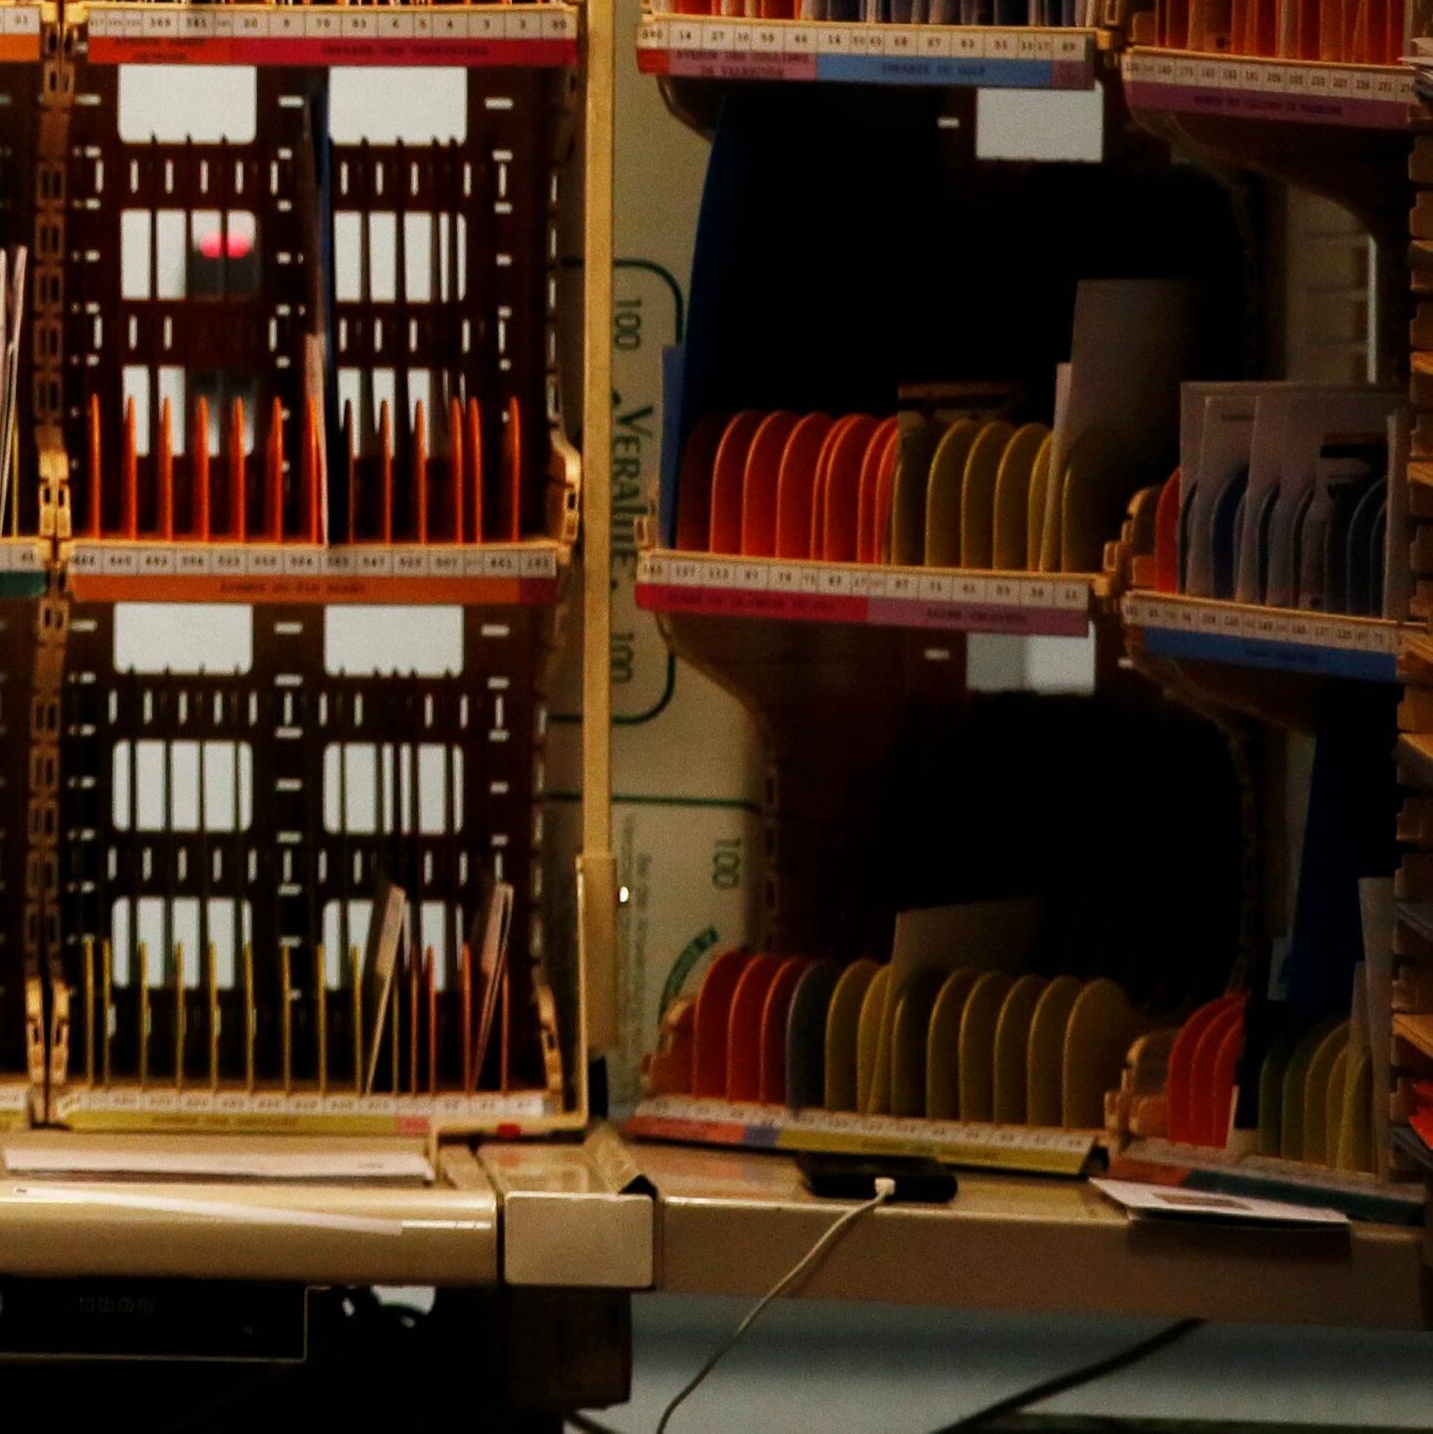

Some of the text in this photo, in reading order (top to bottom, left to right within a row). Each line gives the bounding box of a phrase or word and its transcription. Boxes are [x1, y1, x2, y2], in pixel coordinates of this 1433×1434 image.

[613, 299, 642, 351] 100
[609, 631, 634, 685] 100
[711, 837, 742, 891] 100
